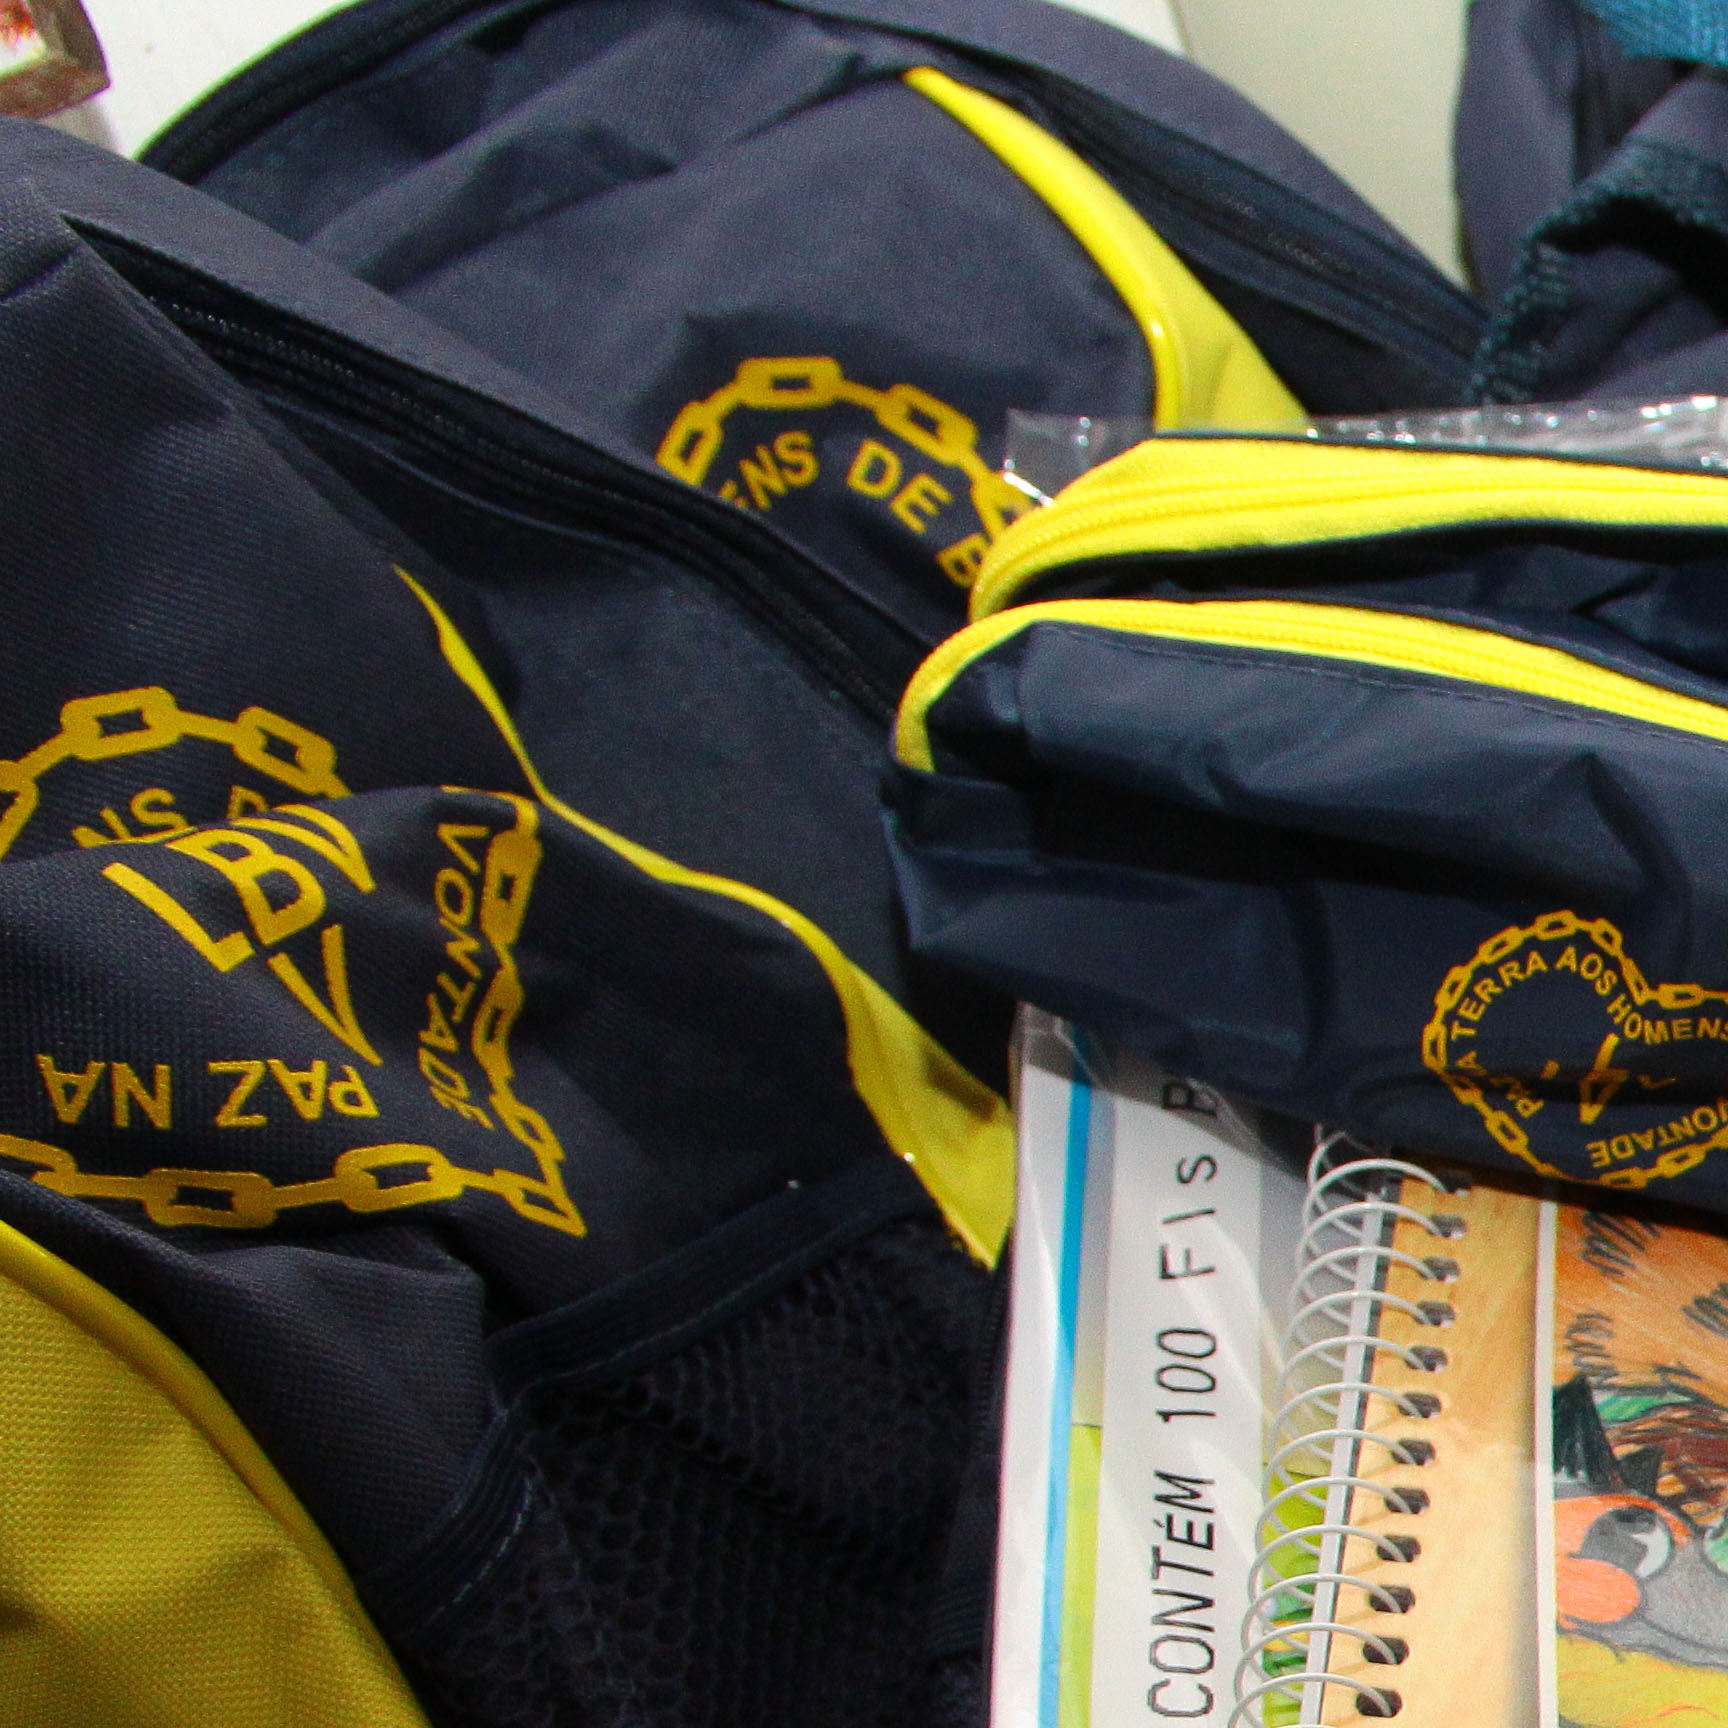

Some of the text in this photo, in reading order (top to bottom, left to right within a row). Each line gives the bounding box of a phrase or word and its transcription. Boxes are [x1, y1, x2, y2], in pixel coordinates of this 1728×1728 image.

[847, 438, 952, 534] DE
[418, 823, 496, 1132] VONTADE
[1451, 950, 1547, 1041] TERRA
[1555, 946, 1619, 996] AOS
[36, 1055, 381, 1130] PAZ NA
[1156, 1325, 1218, 1420] 100
[1146, 1471, 1218, 1718] CONTÉM
